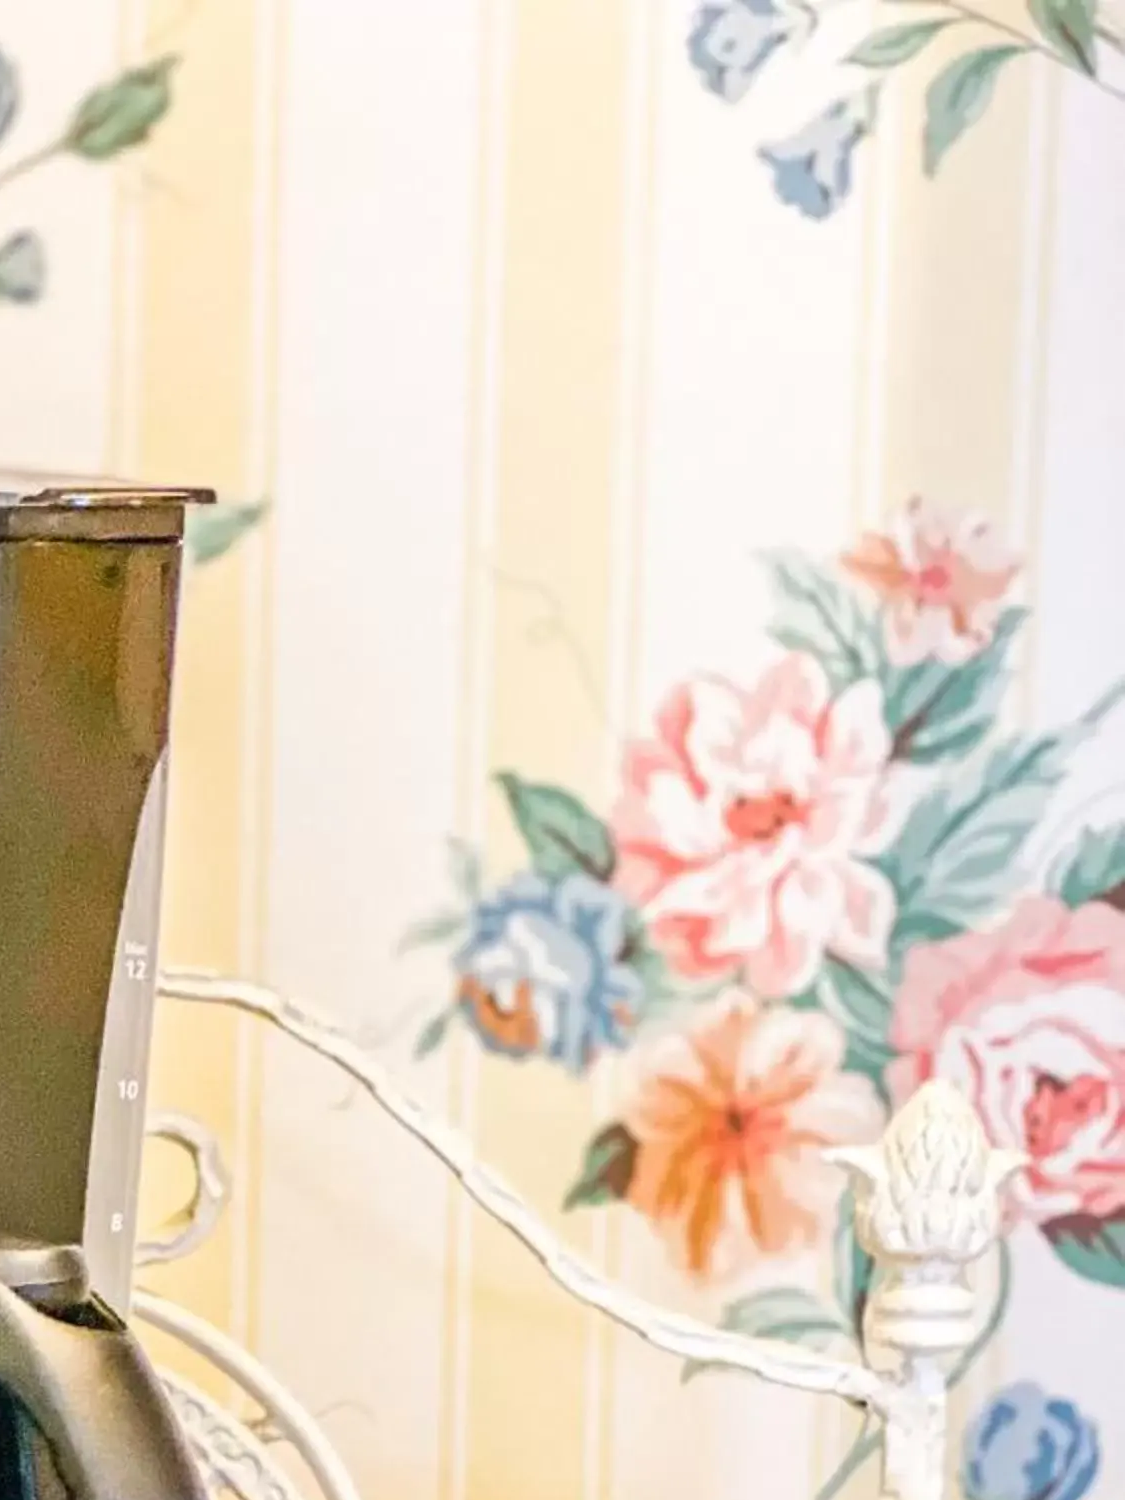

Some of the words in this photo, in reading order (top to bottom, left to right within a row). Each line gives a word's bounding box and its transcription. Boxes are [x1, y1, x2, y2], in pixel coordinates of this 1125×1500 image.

[125, 959, 147, 980] 12
[117, 1079, 139, 1100] 10
[110, 1212, 124, 1233] 8
